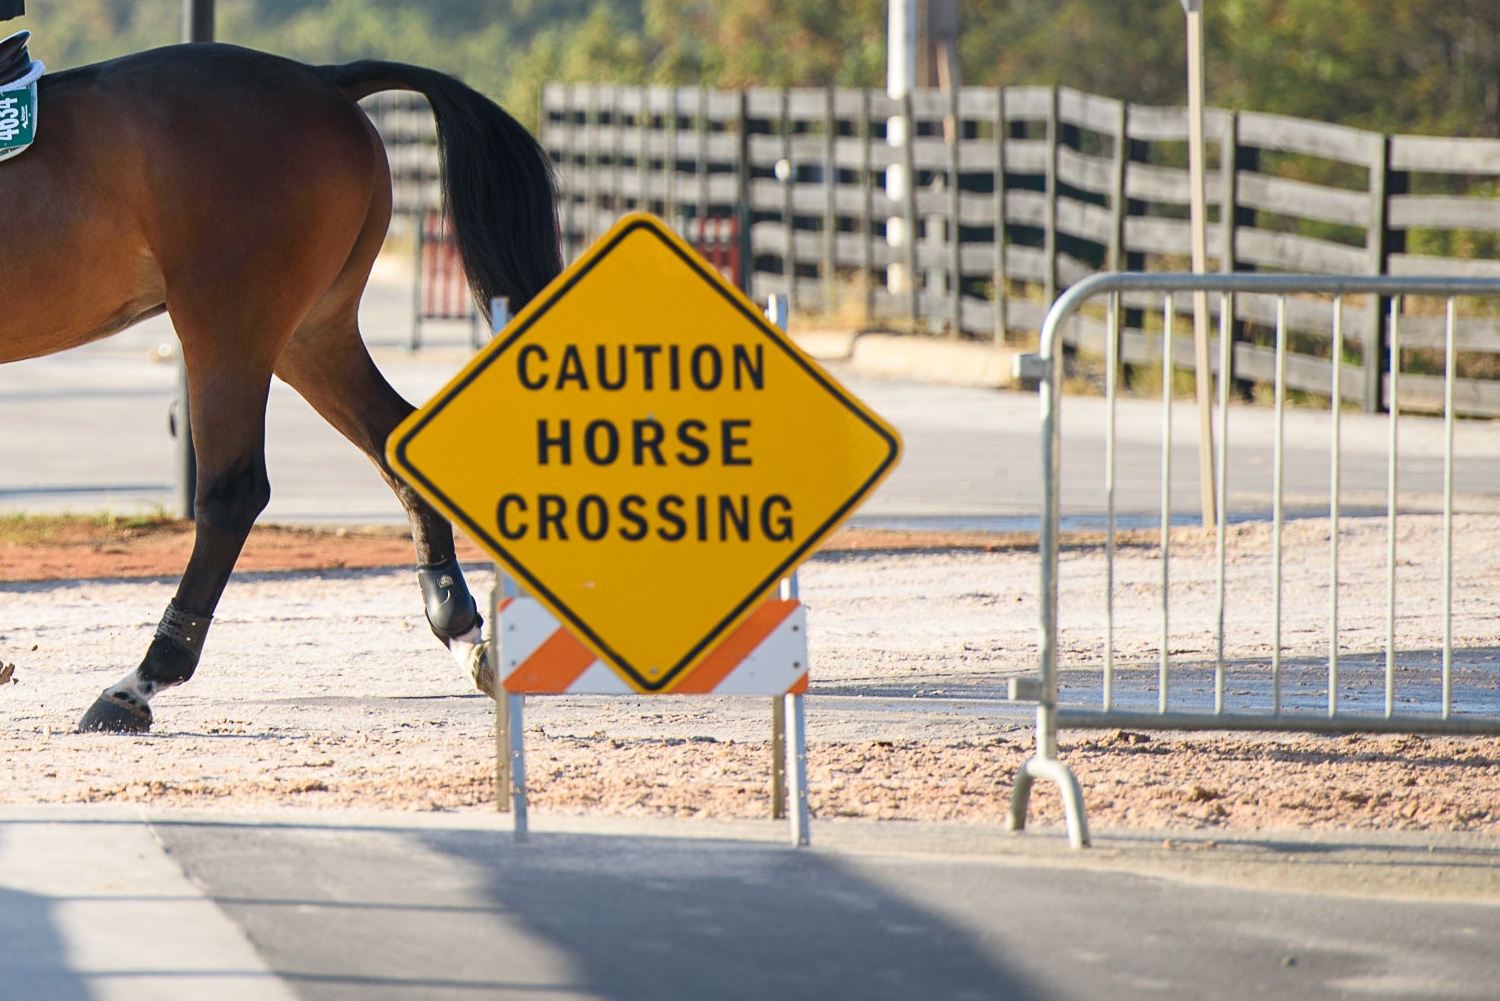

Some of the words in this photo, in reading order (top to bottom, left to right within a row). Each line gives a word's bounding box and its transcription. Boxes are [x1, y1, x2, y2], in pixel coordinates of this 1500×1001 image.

[516, 343, 766, 391] CAUTION
[536, 418, 753, 467] HORSE
[495, 493, 794, 542] CROSSING
